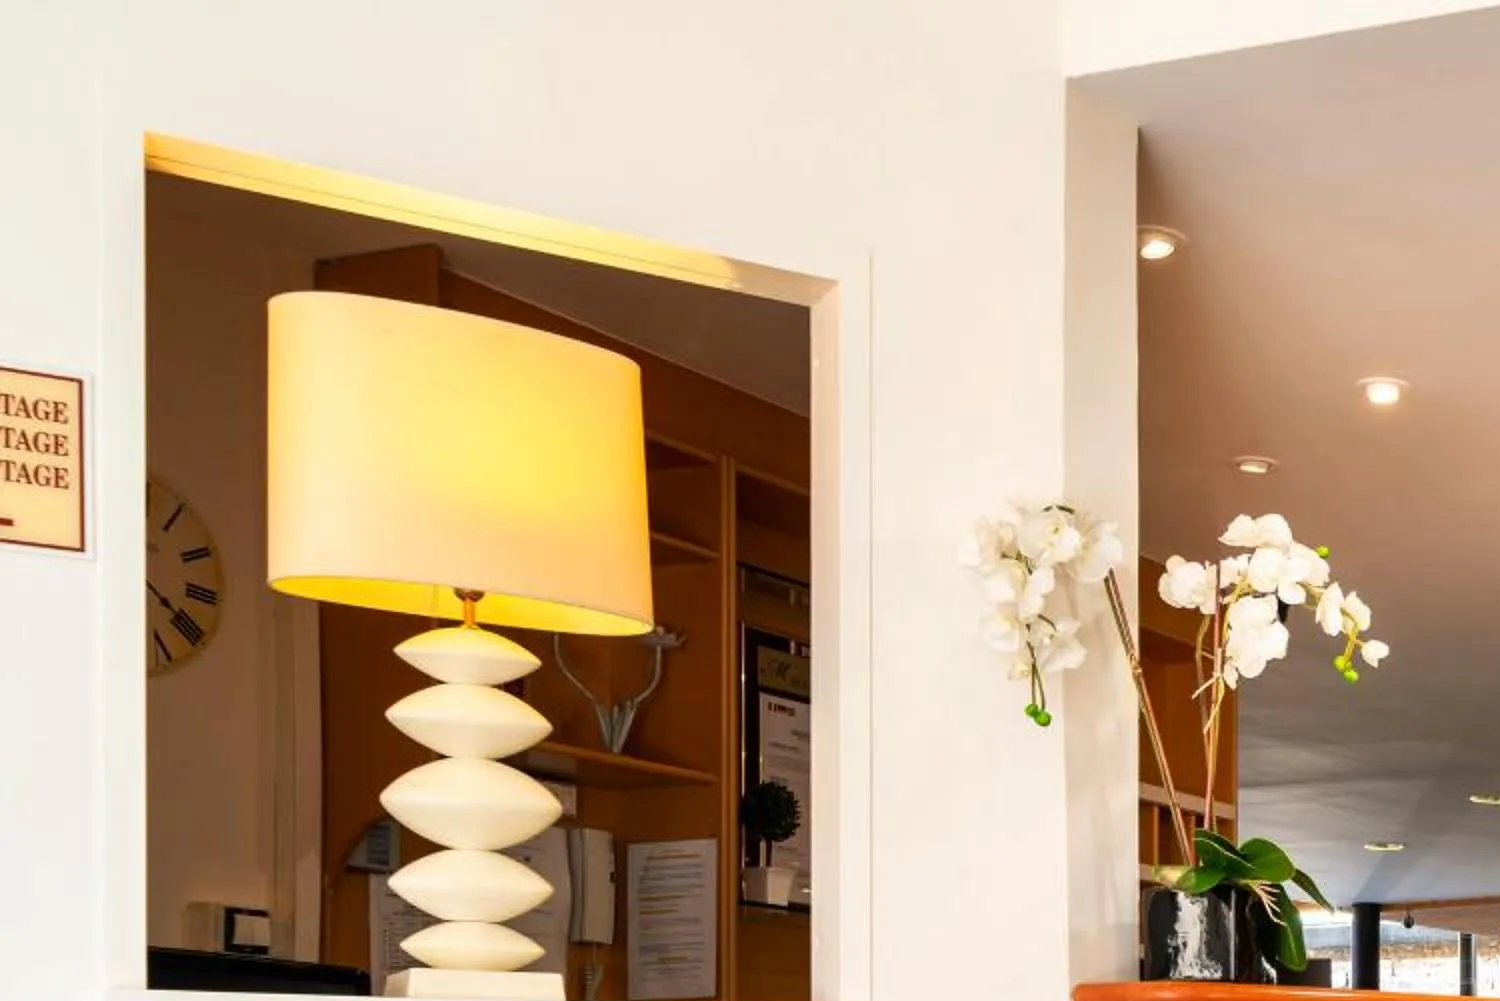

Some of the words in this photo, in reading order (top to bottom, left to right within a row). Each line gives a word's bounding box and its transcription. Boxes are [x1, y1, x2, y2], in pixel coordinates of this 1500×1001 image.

[0, 393, 69, 424] TAGE
[0, 425, 69, 457] TAGE
[0, 458, 69, 490] TAGE
